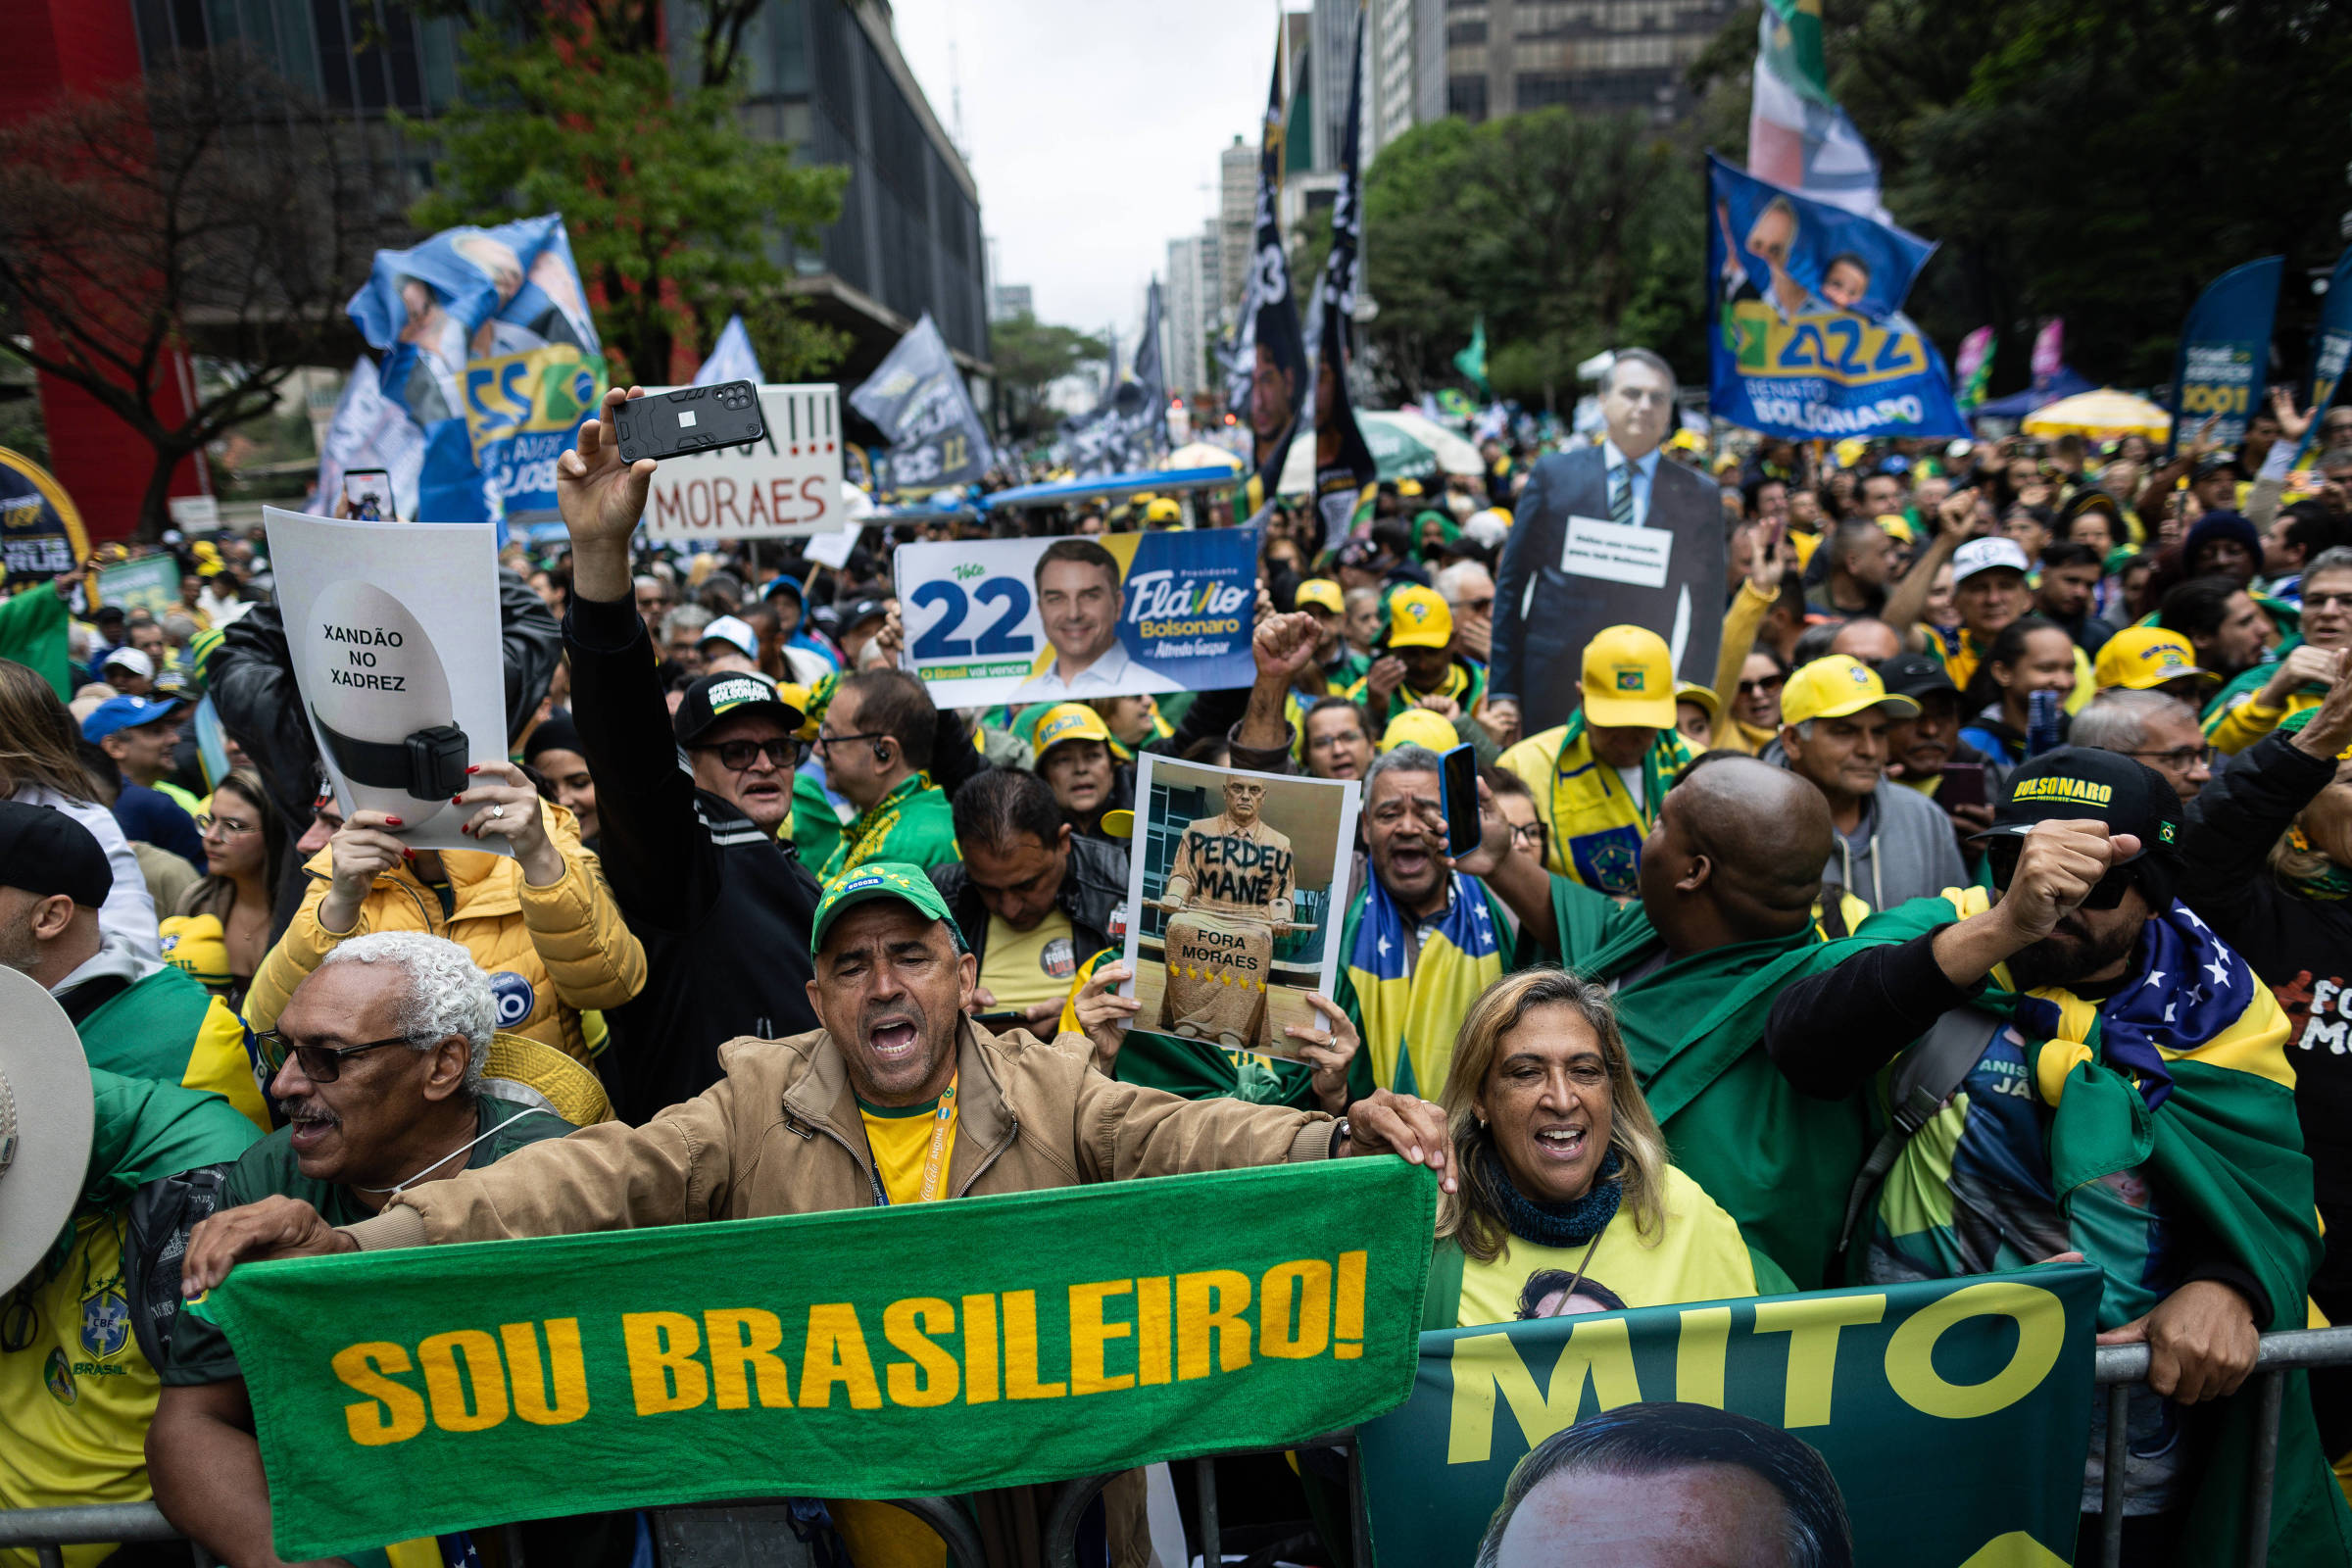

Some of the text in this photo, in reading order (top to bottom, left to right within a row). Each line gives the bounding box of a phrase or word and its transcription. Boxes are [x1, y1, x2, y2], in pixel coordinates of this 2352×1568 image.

[654, 475, 827, 531] MORAES
[952, 564, 986, 581] Vote
[1180, 567, 1238, 577] Presidente
[1127, 569, 1250, 624] Flávio
[910, 576, 1034, 660] 22
[1140, 618, 1240, 639] Bolsonaro
[323, 624, 403, 648] XANDÃO
[349, 650, 376, 667] NO
[331, 668, 407, 692] XADREZ
[921, 663, 1028, 680] O Brasil vai vencer
[2014, 776, 2112, 803] BOLSONARO
[1189, 832, 1292, 875] PERDEU
[1198, 929, 1246, 950] FORA
[1045, 946, 1074, 965] FORA
[1182, 945, 1258, 970] MORAES
[1979, 1058, 2029, 1078] ANIS
[931, 1127, 945, 1160] ANDINA
[93, 1318, 115, 1329] CBF
[330, 1250, 1368, 1446] SOU BRASILEIRO!
[73, 1362, 127, 1376] BRASIL
[1446, 1282, 2066, 1465] MITO
